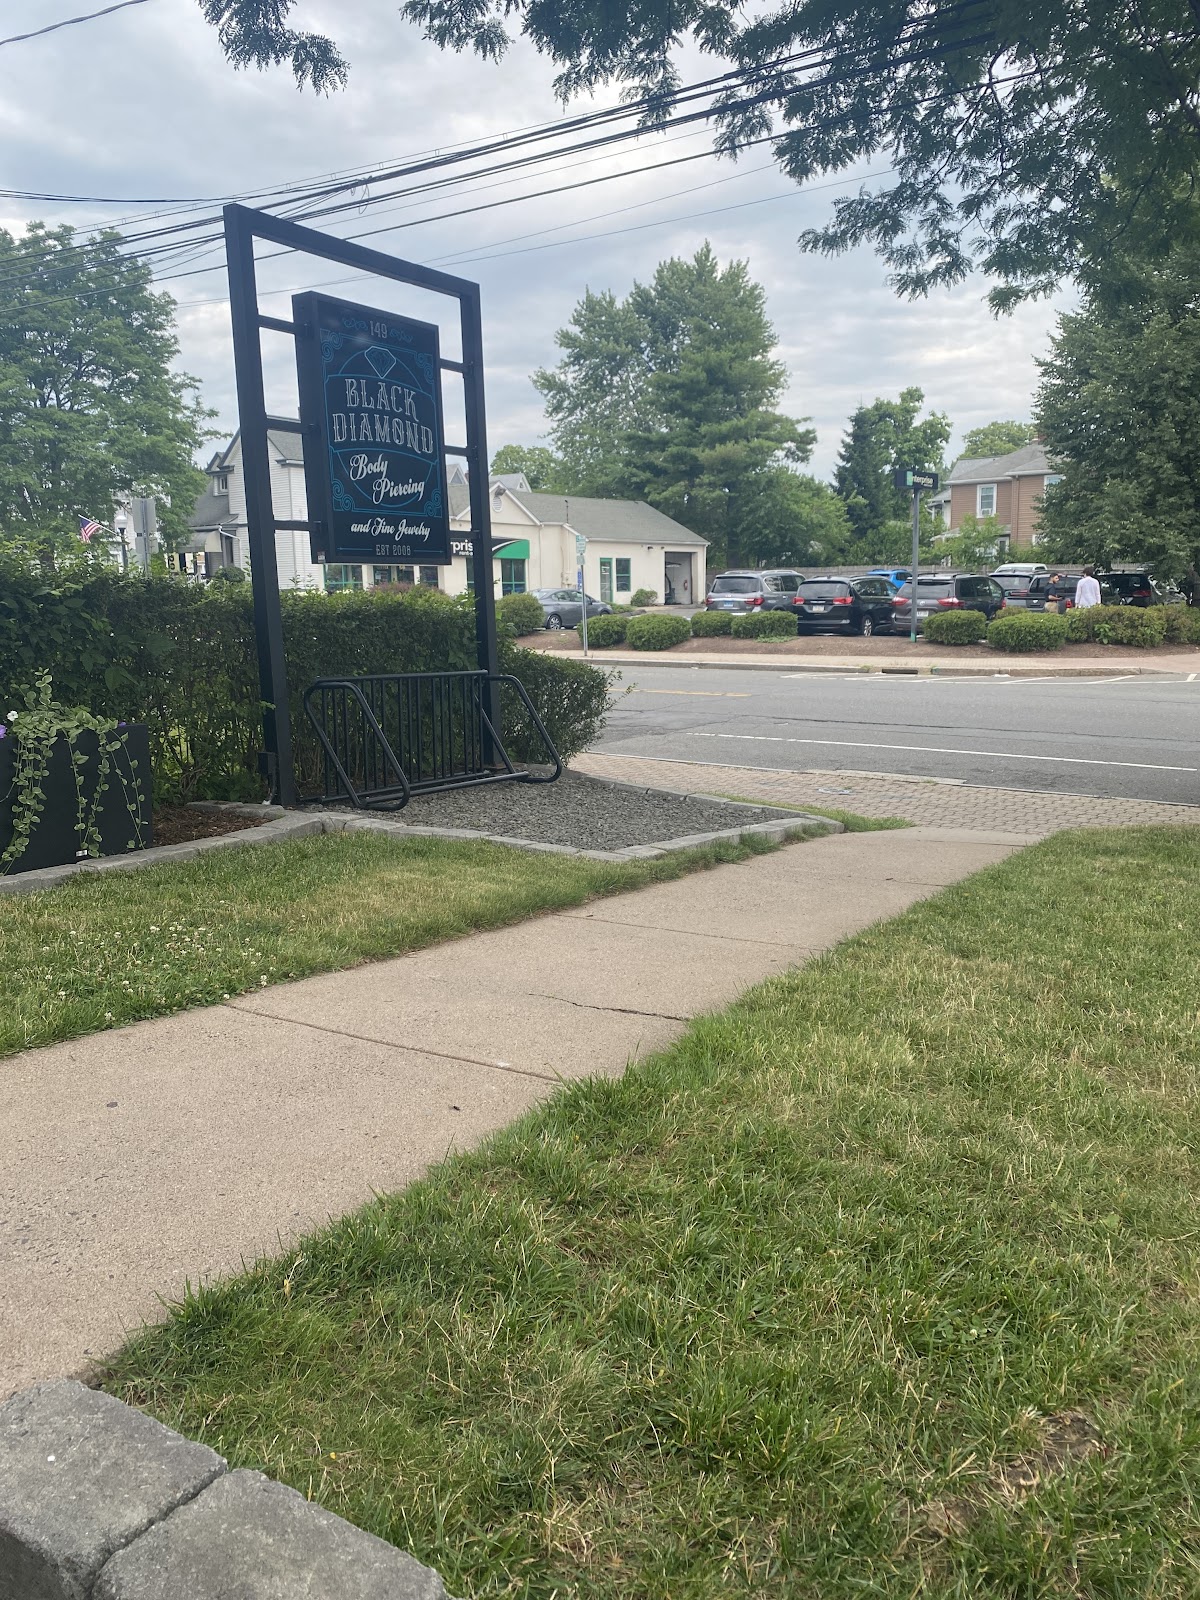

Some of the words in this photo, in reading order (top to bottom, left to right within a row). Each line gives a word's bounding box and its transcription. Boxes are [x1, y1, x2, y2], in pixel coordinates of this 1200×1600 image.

[370, 320, 388, 339] 149
[345, 378, 419, 422] BLACK
[332, 412, 433, 453] DIAMOND
[350, 453, 388, 480] Body
[372, 478, 425, 504] Piercing
[350, 519, 372, 533] and
[371, 517, 395, 536] Fine
[395, 518, 431, 542] Jewelry
[375, 544, 389, 555] EST
[392, 544, 411, 556] 2008
